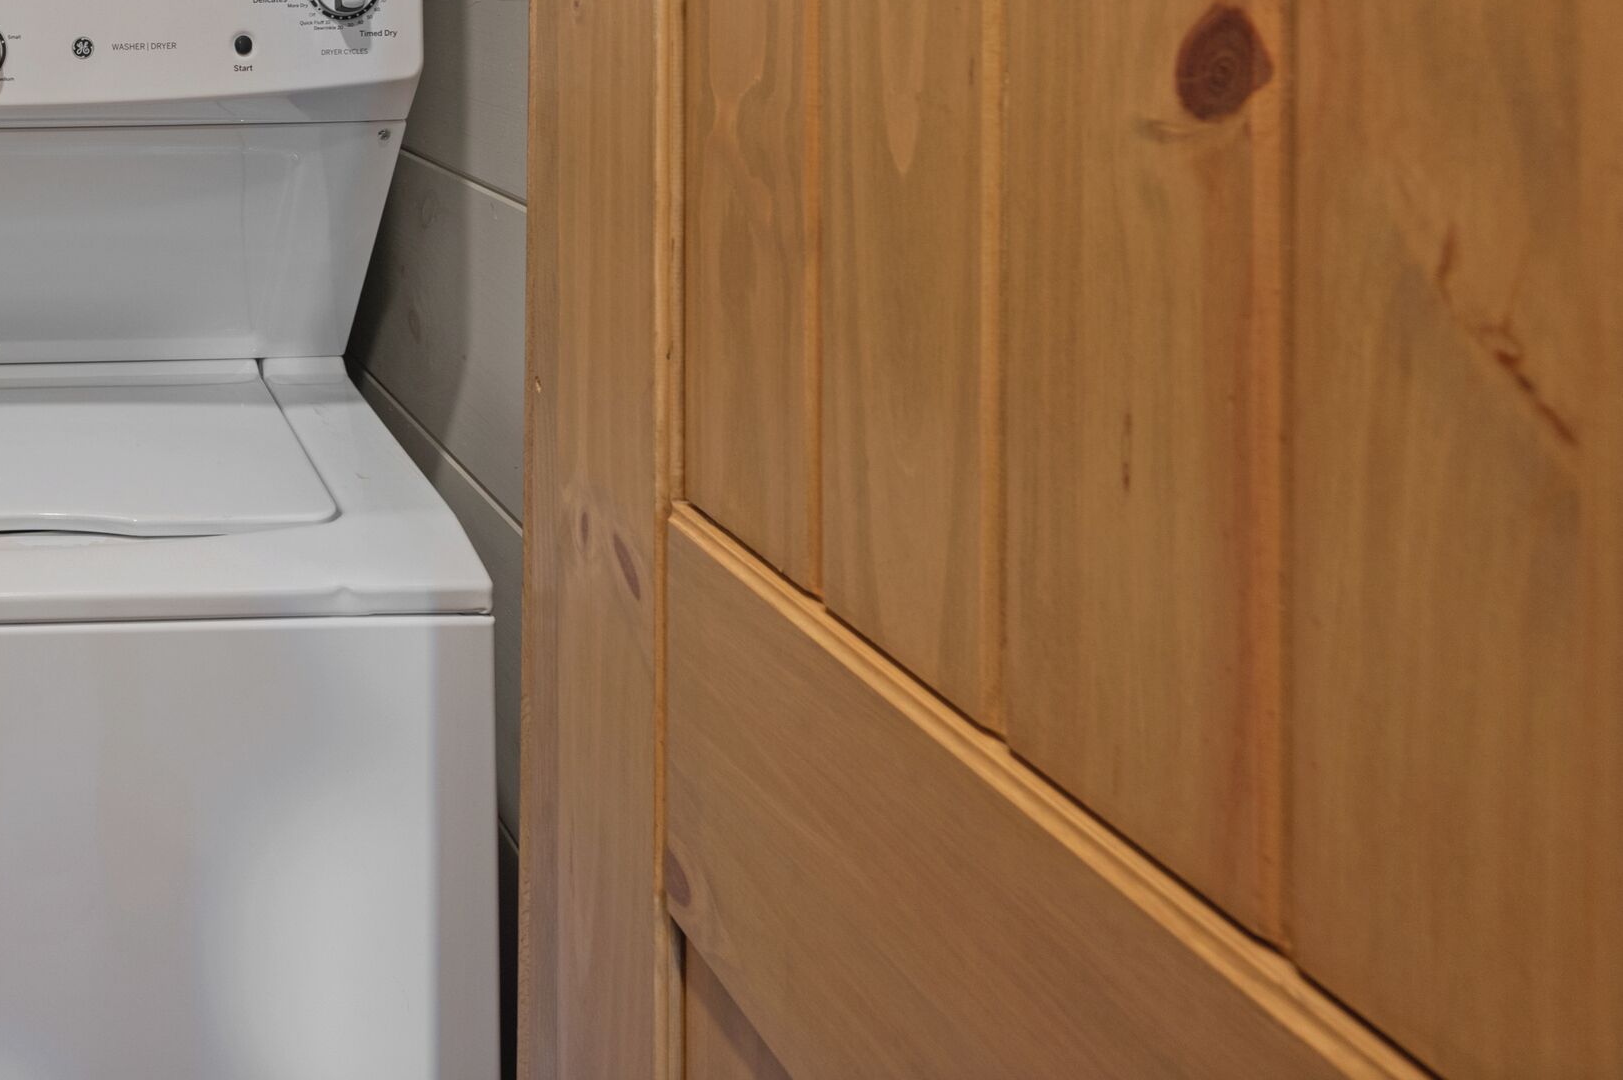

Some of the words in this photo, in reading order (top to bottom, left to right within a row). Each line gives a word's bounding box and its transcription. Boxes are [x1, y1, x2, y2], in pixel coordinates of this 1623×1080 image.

[384, 30, 398, 38] Dry
[112, 42, 146, 51] WASHER
[150, 42, 178, 50] DRYER
[234, 64, 253, 72] Start
